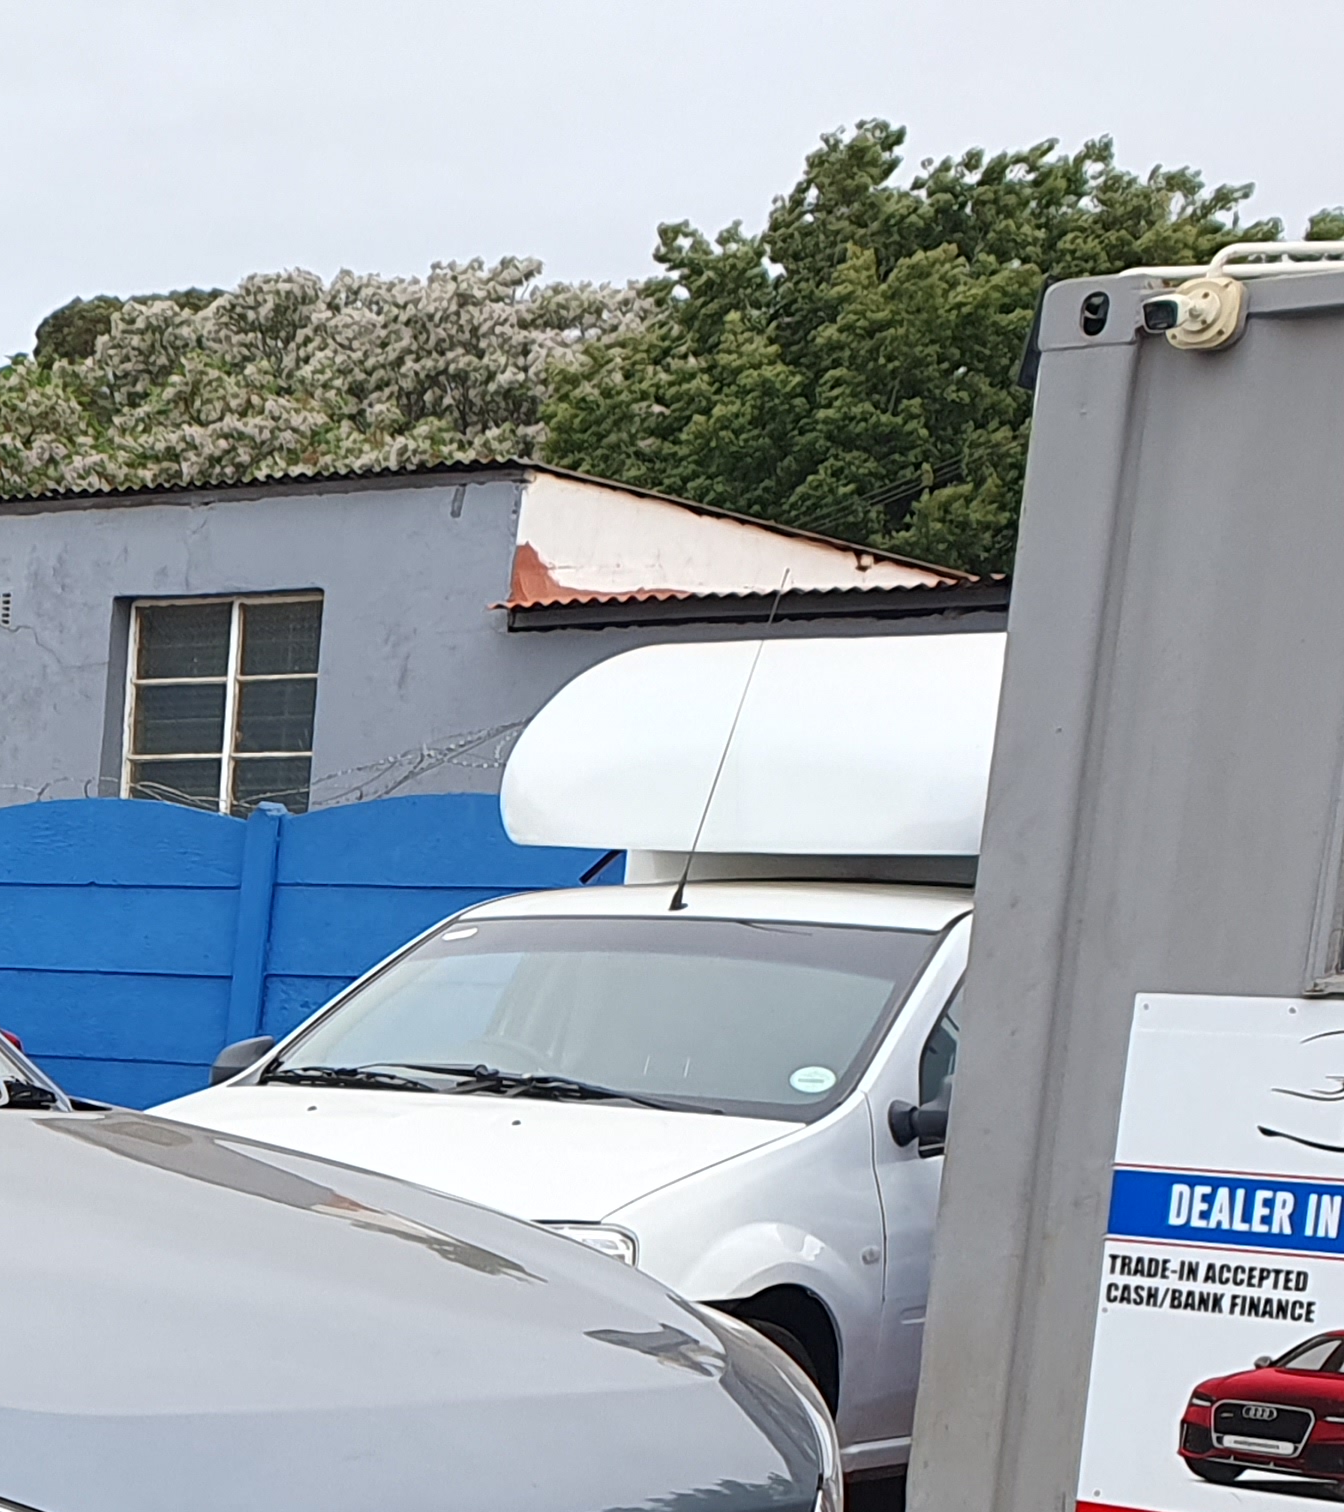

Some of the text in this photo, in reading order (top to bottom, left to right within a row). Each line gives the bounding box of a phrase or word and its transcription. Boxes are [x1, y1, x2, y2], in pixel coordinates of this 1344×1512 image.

[1168, 1183, 1343, 1239] DEALER IN
[1108, 1254, 1310, 1292] TRADE-IN ACCEPTED
[1106, 1282, 1317, 1323] CASH/BANK FINANCE
